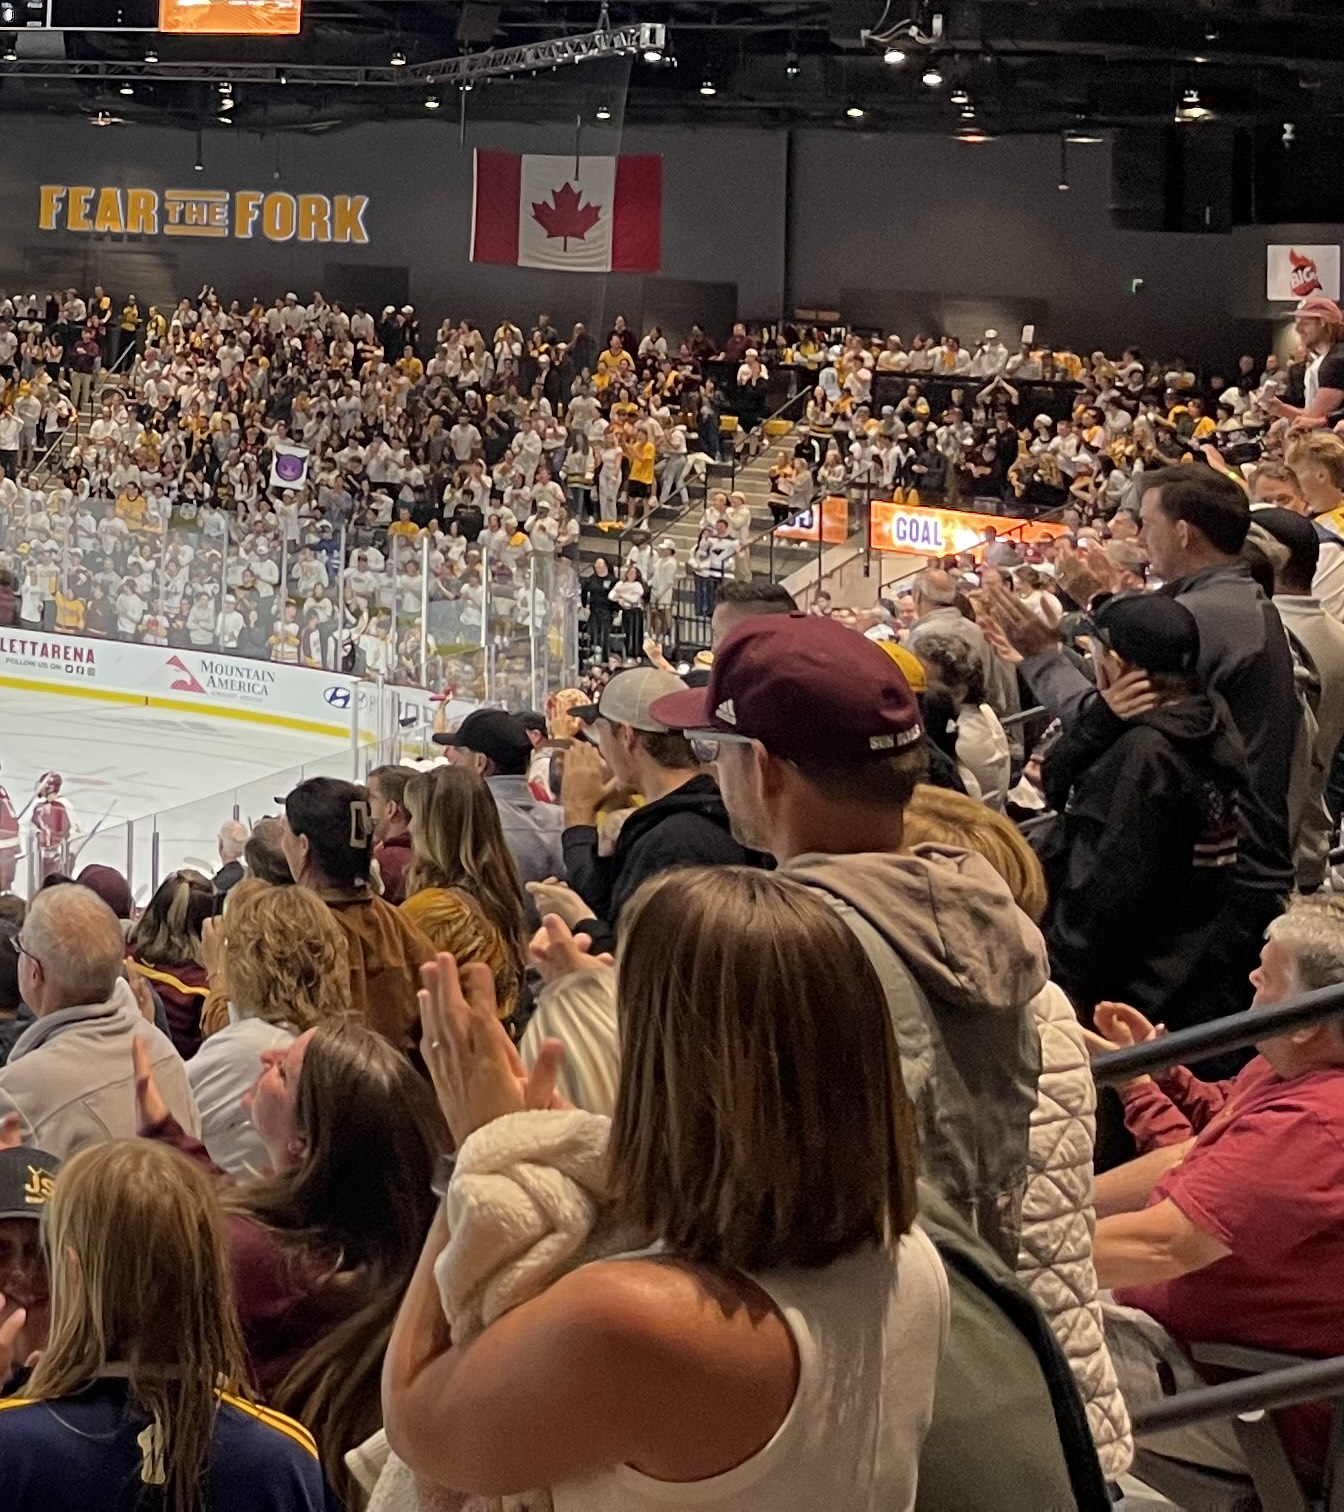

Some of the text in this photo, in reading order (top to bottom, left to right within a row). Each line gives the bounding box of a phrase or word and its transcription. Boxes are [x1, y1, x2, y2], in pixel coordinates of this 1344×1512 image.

[39, 185, 370, 243] FEAR THE FORK
[894, 514, 944, 548] GOAL
[201, 659, 275, 683] MOUNTAIN
[206, 675, 269, 696] AMERICA
